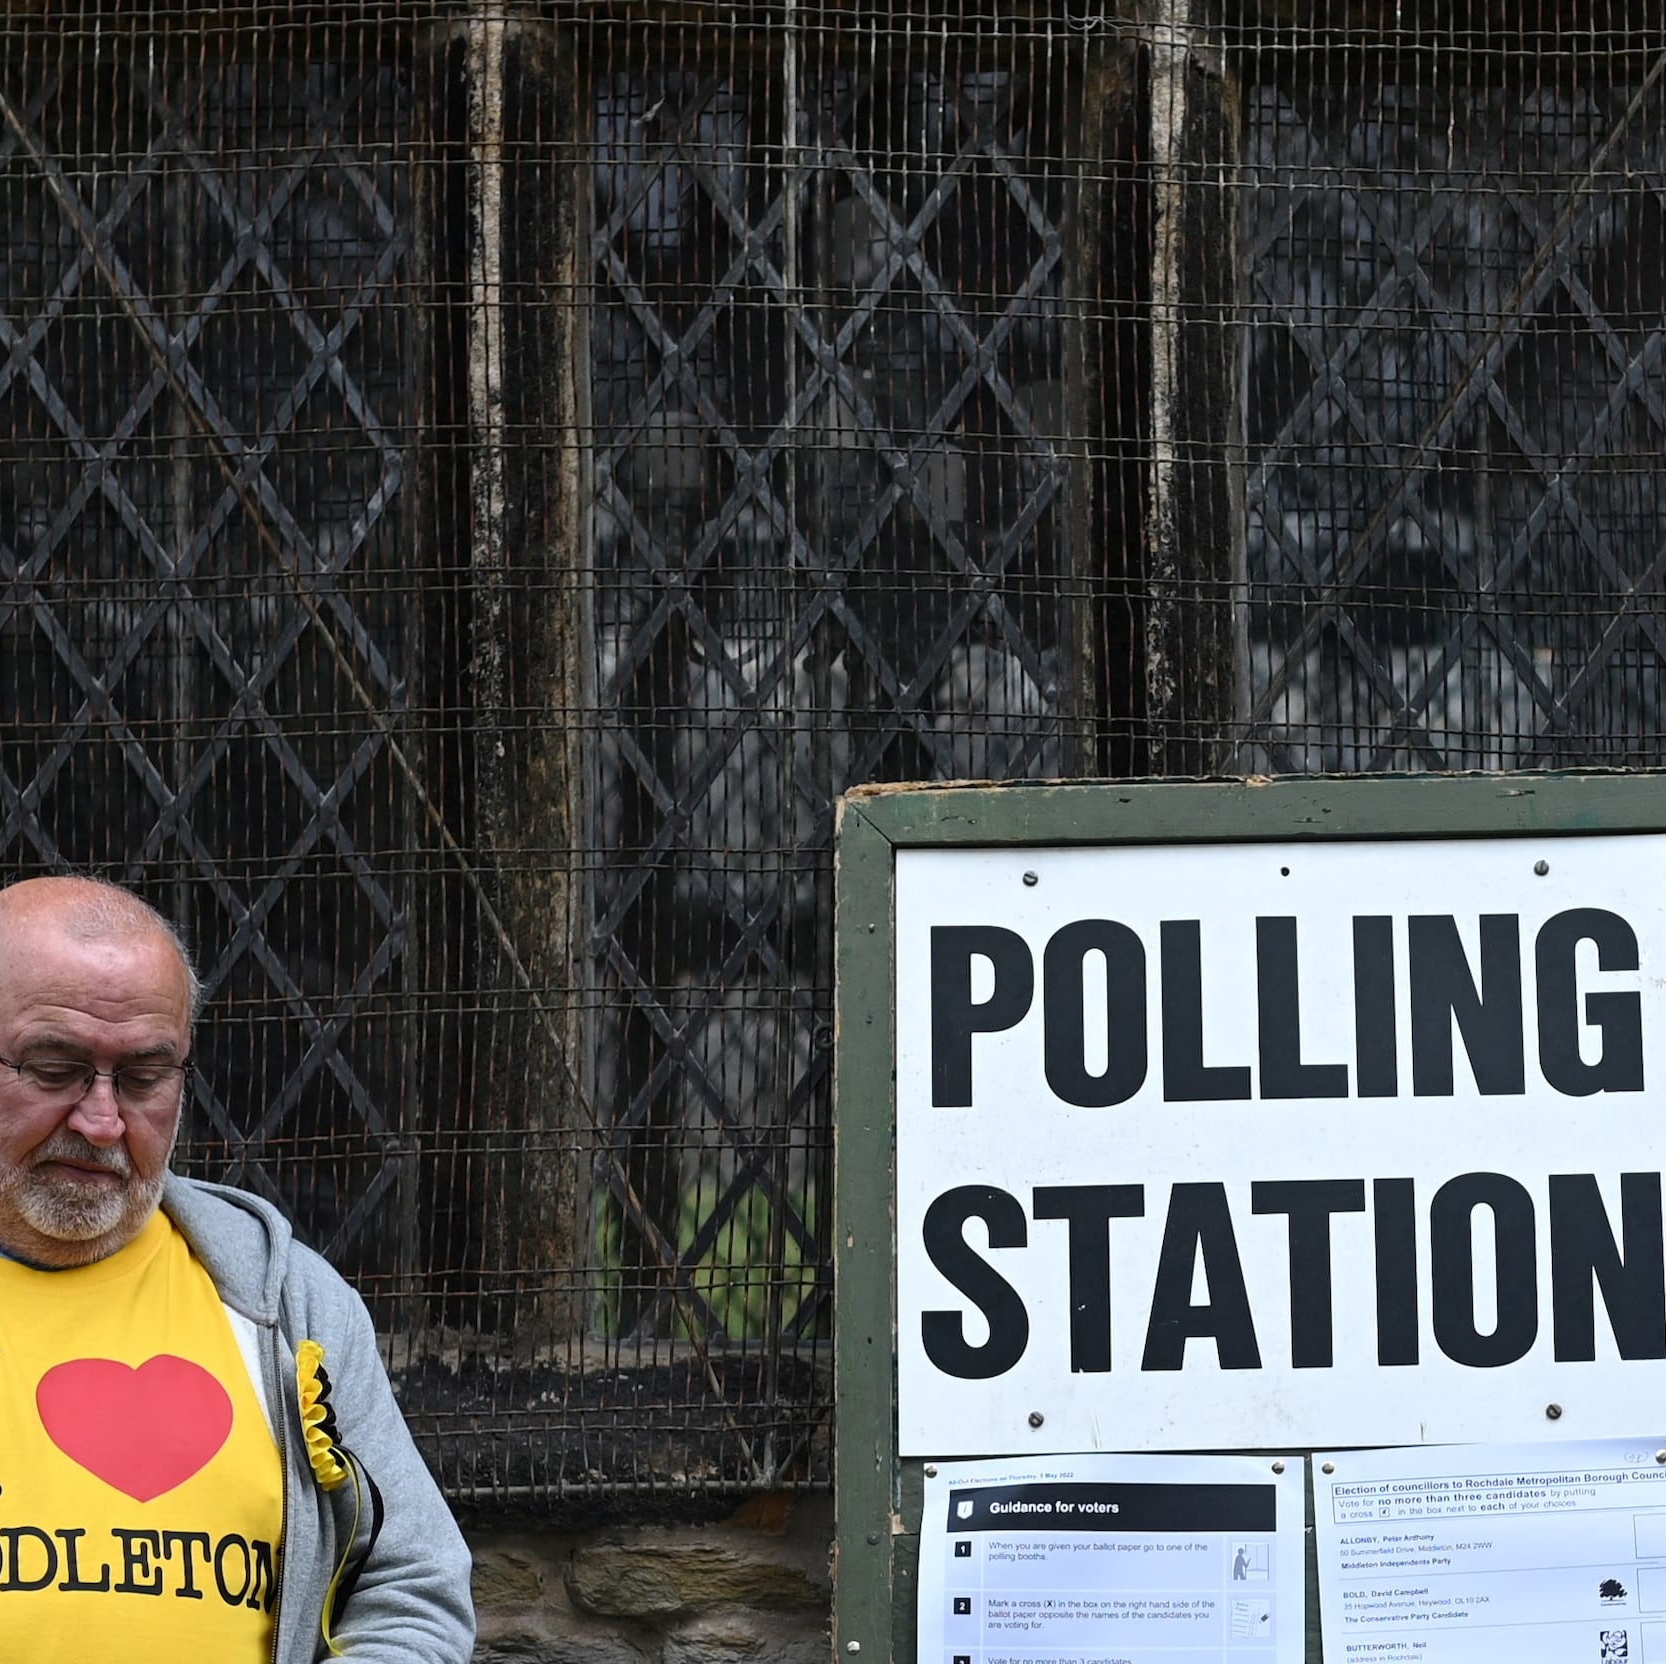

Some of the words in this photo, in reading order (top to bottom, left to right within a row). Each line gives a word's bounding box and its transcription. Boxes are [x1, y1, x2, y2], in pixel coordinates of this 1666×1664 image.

[930, 908, 1644, 1107] POLLING
[921, 1172, 1666, 1379] STATION
[1334, 1486, 1376, 1496] Election
[1379, 1483, 1390, 1495] of
[1392, 1481, 1449, 1494] councillors
[1465, 1478, 1513, 1487] Rochdale
[1516, 1475, 1580, 1487] Metropolitan
[1583, 1472, 1628, 1483] Borough
[989, 1501, 1052, 1513] Guidance
[1055, 1500, 1075, 1512] for
[1077, 1501, 1119, 1513] voters
[1394, 1496, 1422, 1504] more
[1425, 1494, 1450, 1503] than
[1453, 1492, 1482, 1501] three
[1485, 1490, 1546, 1500] candidates
[987, 1657, 1007, 1664] Vote
[1009, 1656, 1020, 1664] for
